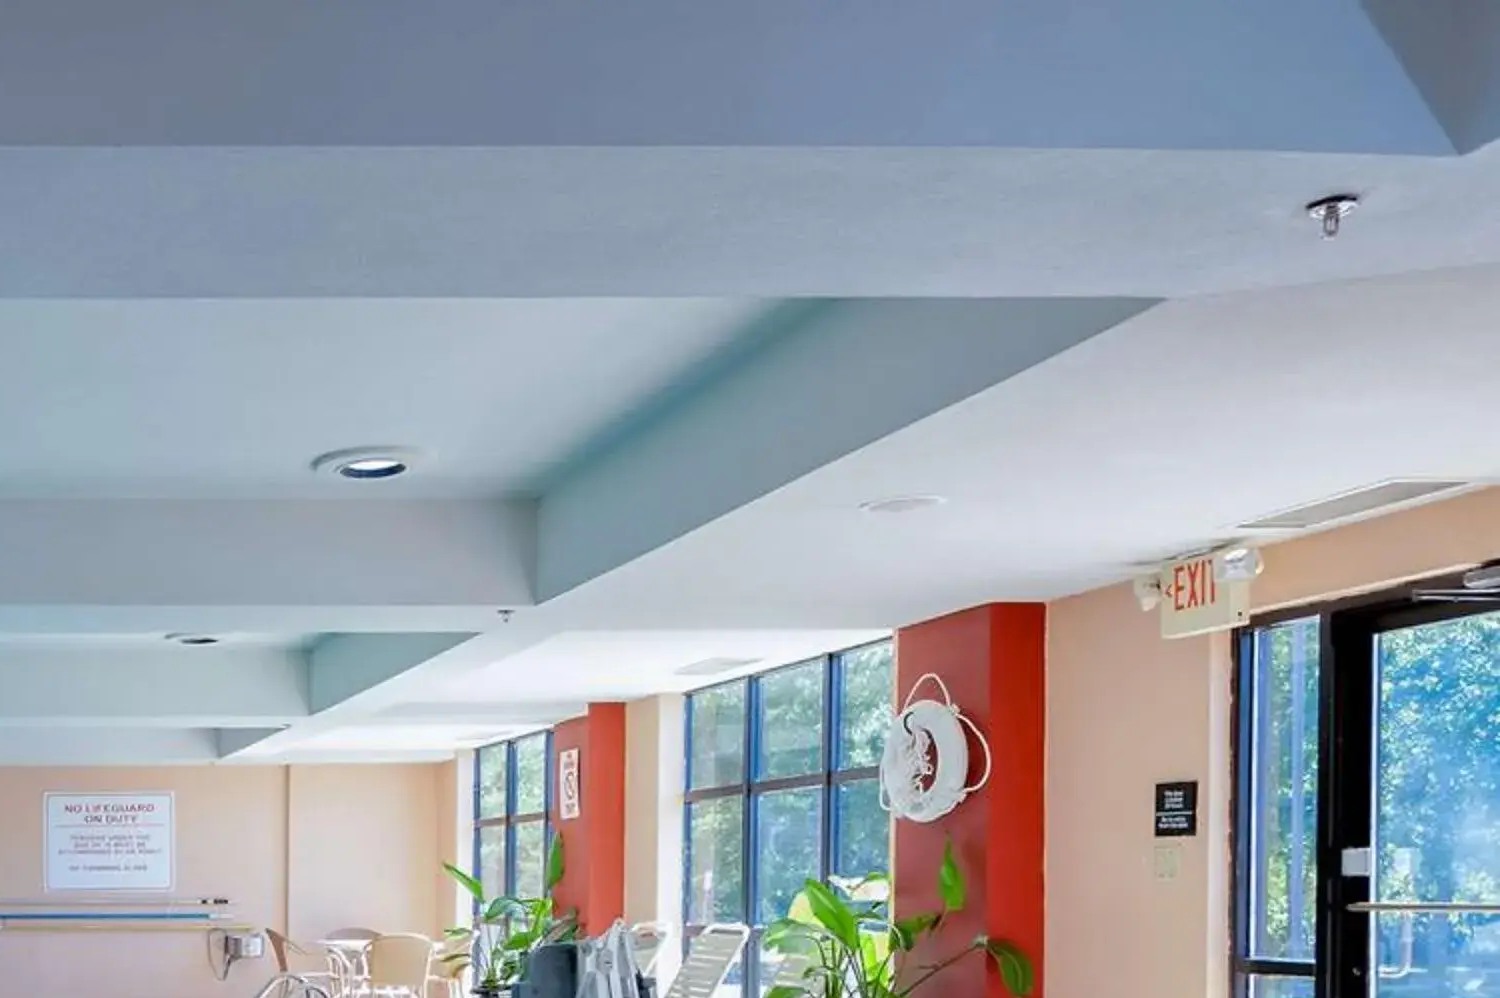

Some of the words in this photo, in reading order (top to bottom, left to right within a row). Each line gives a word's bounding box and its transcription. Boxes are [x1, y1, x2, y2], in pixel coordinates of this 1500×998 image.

[1174, 558, 1215, 611] EXIT
[64, 803, 82, 813] NO
[86, 803, 155, 813] LIFEGUARD
[84, 815, 102, 824] ON
[105, 815, 138, 824] DUTY
